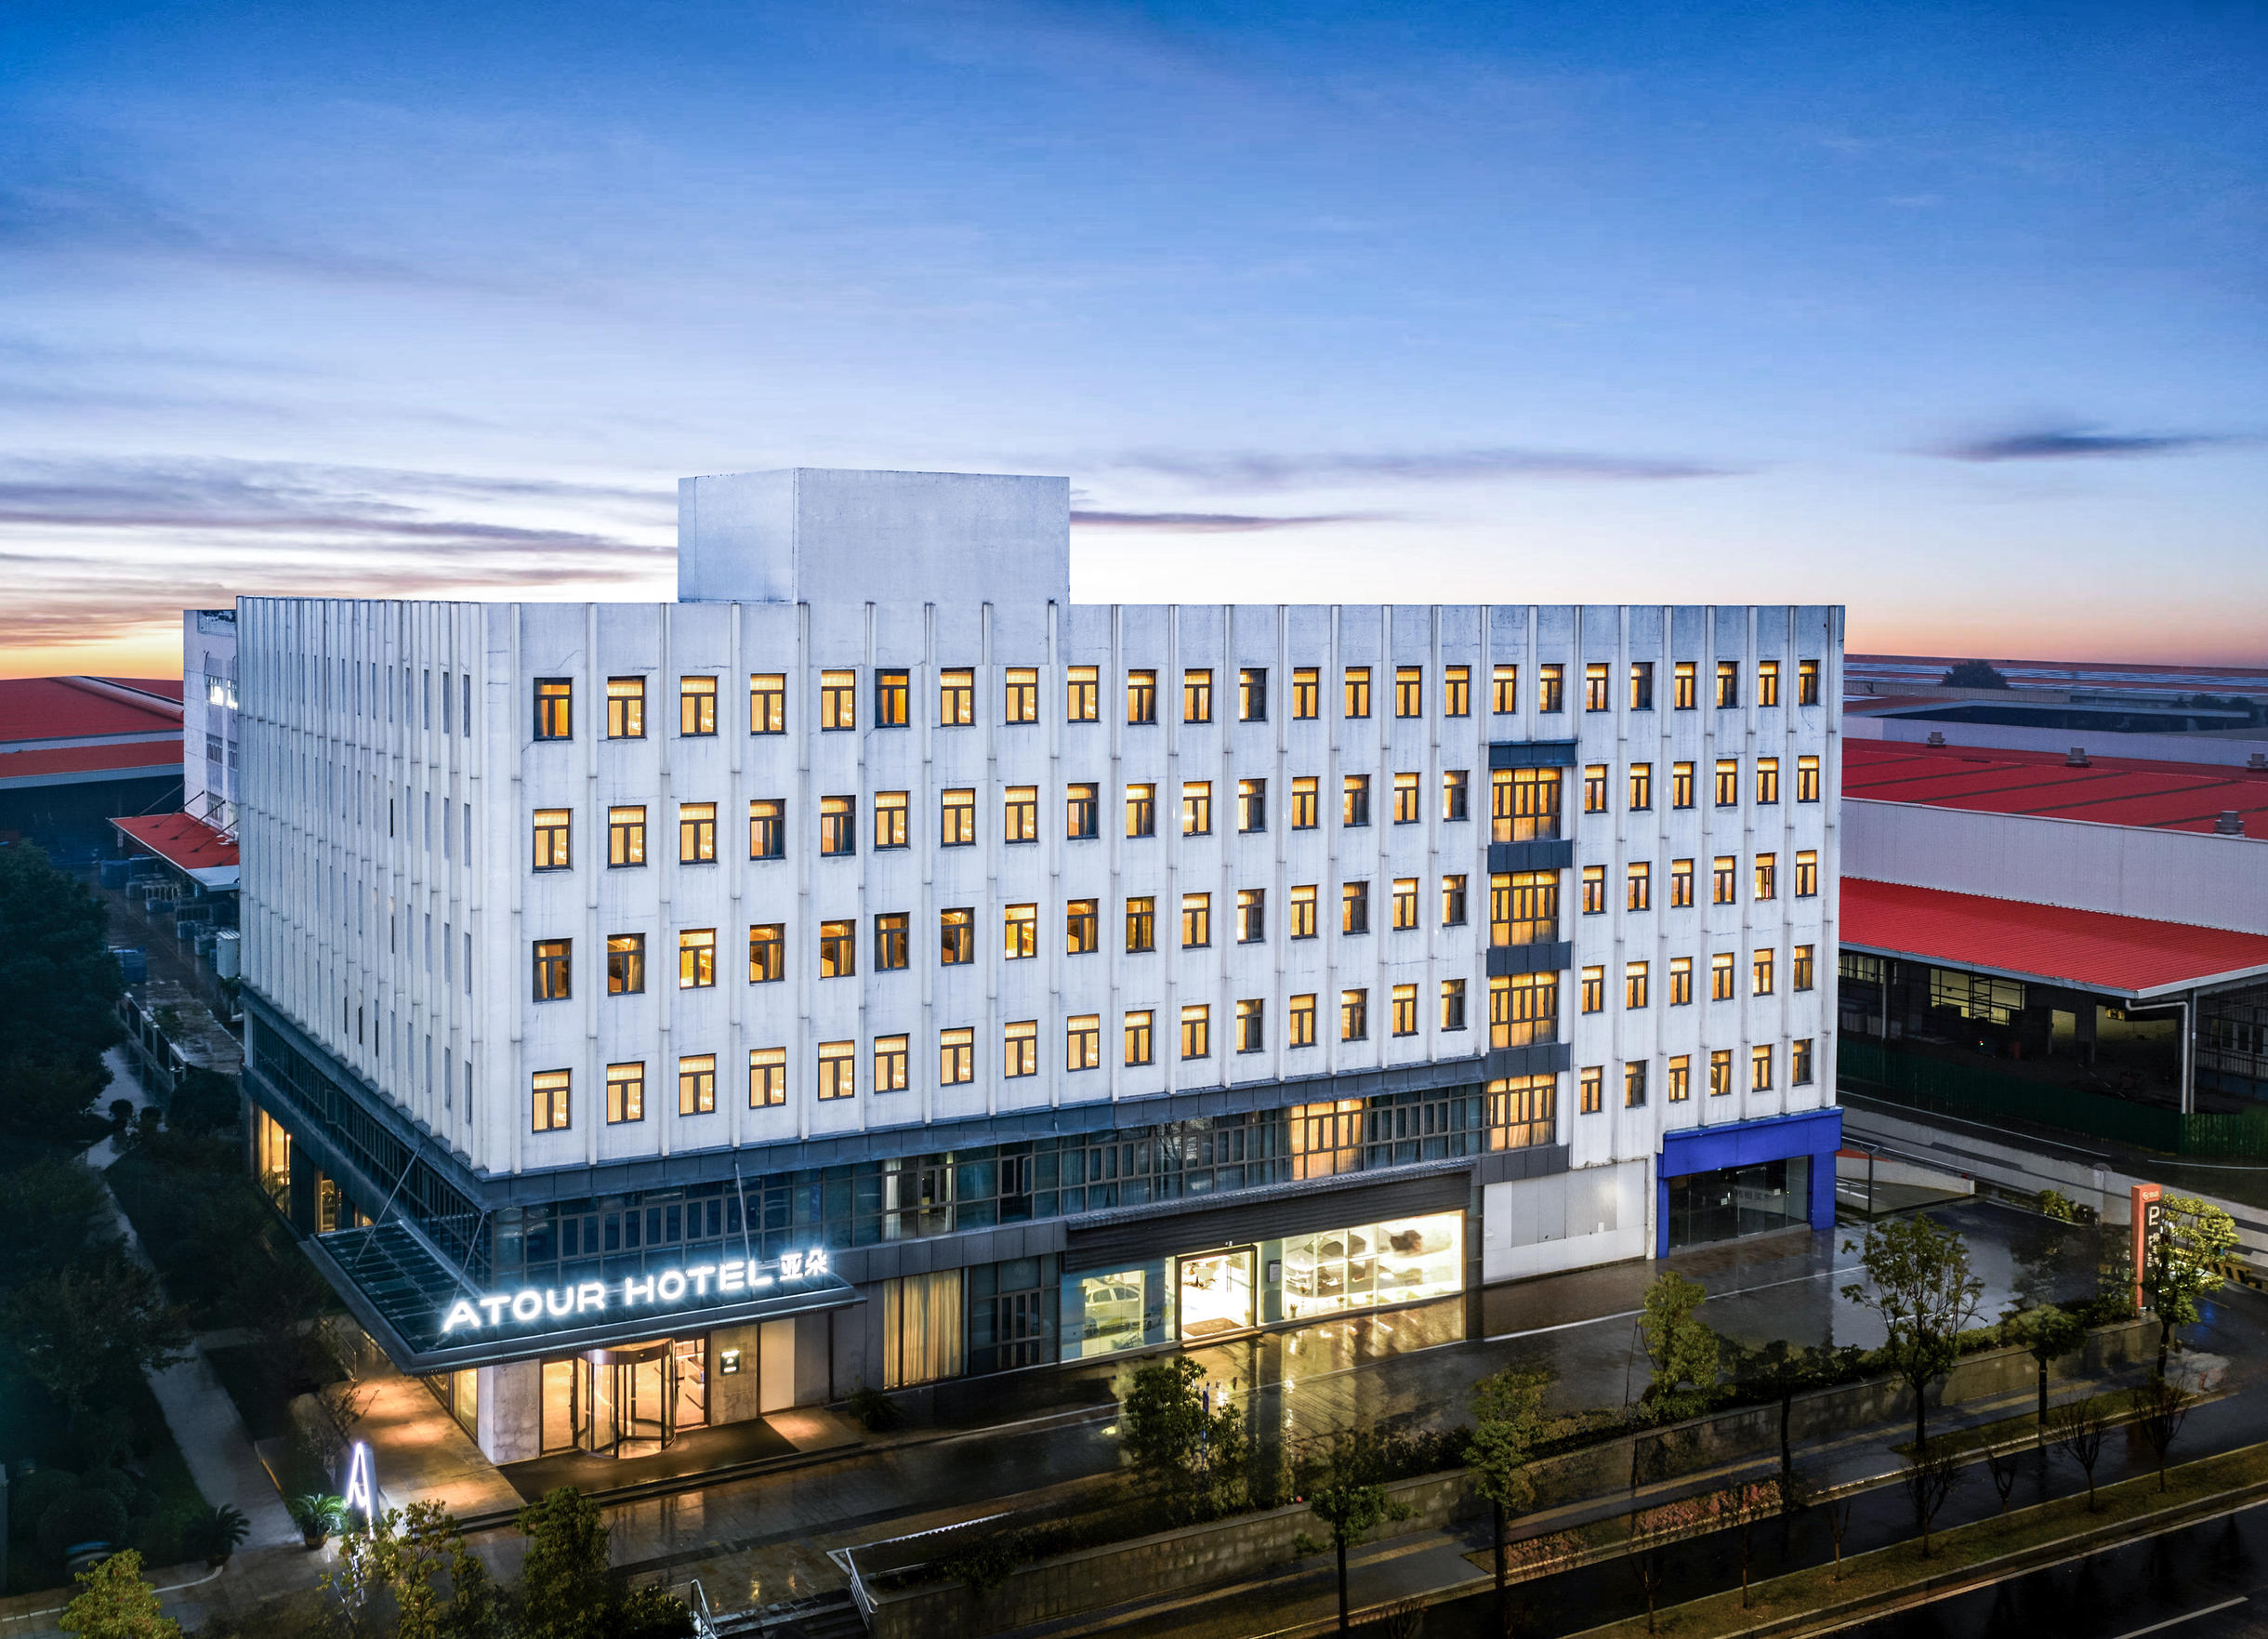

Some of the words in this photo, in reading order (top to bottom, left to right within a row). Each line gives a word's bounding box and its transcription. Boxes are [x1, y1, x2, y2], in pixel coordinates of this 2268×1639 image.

[442, 1281, 606, 1332] ATOUR
[625, 1259, 772, 1305] HOTEL
[779, 1249, 829, 1282] 亚朵
